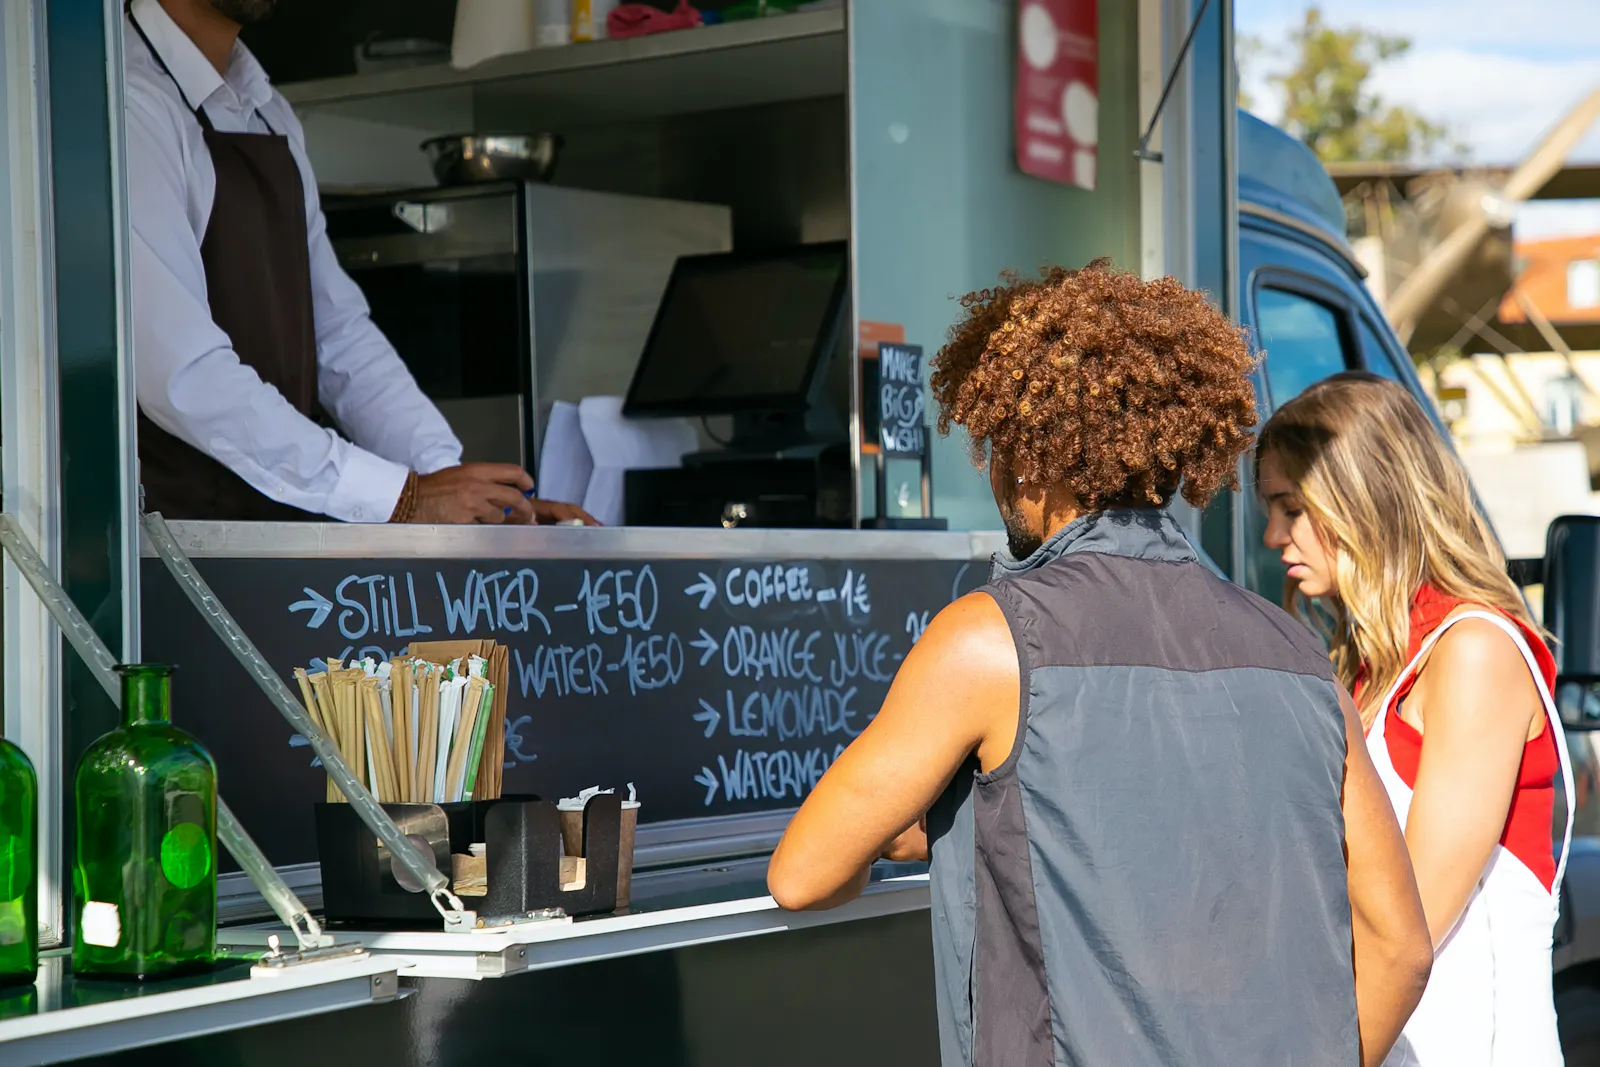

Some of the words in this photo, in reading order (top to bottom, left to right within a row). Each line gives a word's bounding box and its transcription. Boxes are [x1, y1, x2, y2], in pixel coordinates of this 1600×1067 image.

[881, 347, 917, 384] MAKE
[436, 568, 551, 635] WATER
[725, 565, 813, 607] COFFEE
[514, 643, 609, 698] WATER
[723, 626, 822, 681] ORANGE
[726, 684, 864, 741] LEMONADE
[717, 743, 845, 801] WATERME
